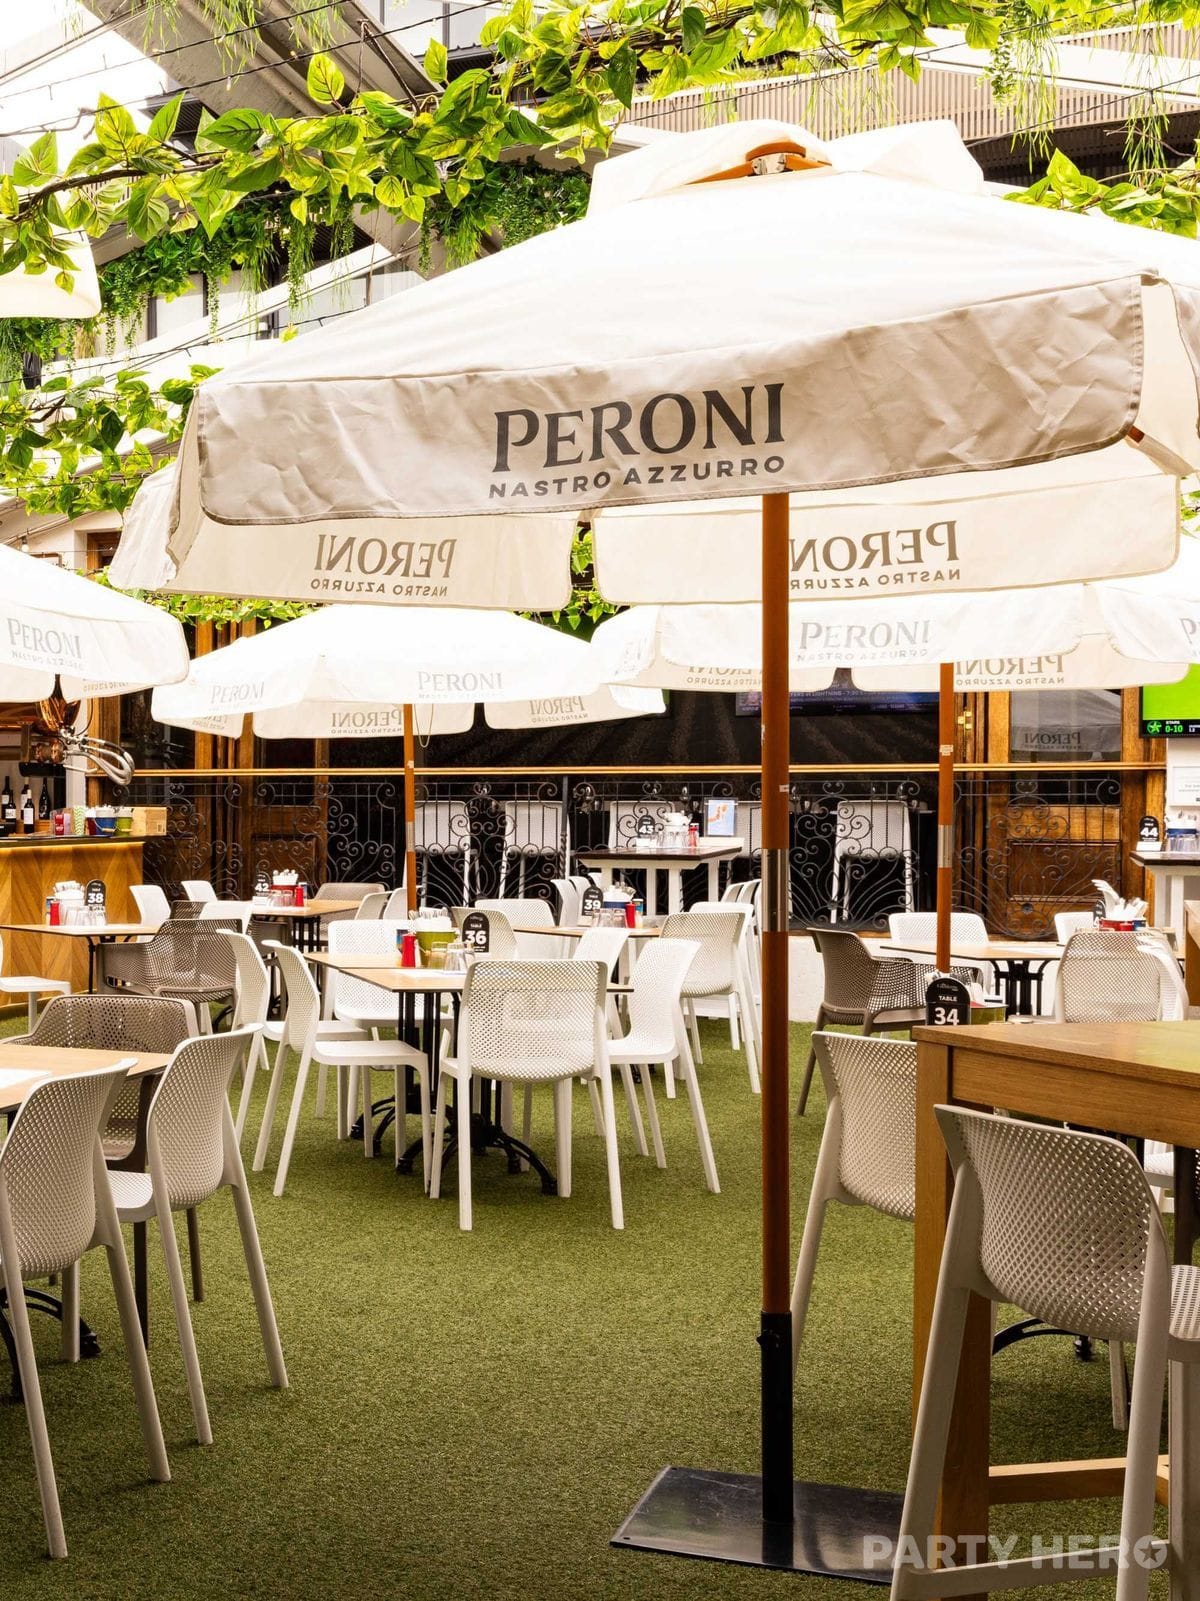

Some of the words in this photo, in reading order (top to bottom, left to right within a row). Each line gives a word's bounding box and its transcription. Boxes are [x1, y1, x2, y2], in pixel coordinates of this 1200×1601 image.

[492, 383, 785, 472] PERONI
[489, 472, 611, 498] NASTRO
[623, 456, 785, 485] AZZURRO
[8, 618, 82, 659] PERONI
[800, 620, 930, 649] PERONI
[418, 671, 502, 691] PERONI
[211, 682, 264, 704] PERONI
[639, 825, 653, 833] 43
[1140, 827, 1158, 837] 44
[255, 883, 269, 891] 42
[88, 893, 103, 903] 38
[584, 900, 601, 910] 39
[465, 930, 487, 945] 36
[934, 1007, 960, 1026] 34
